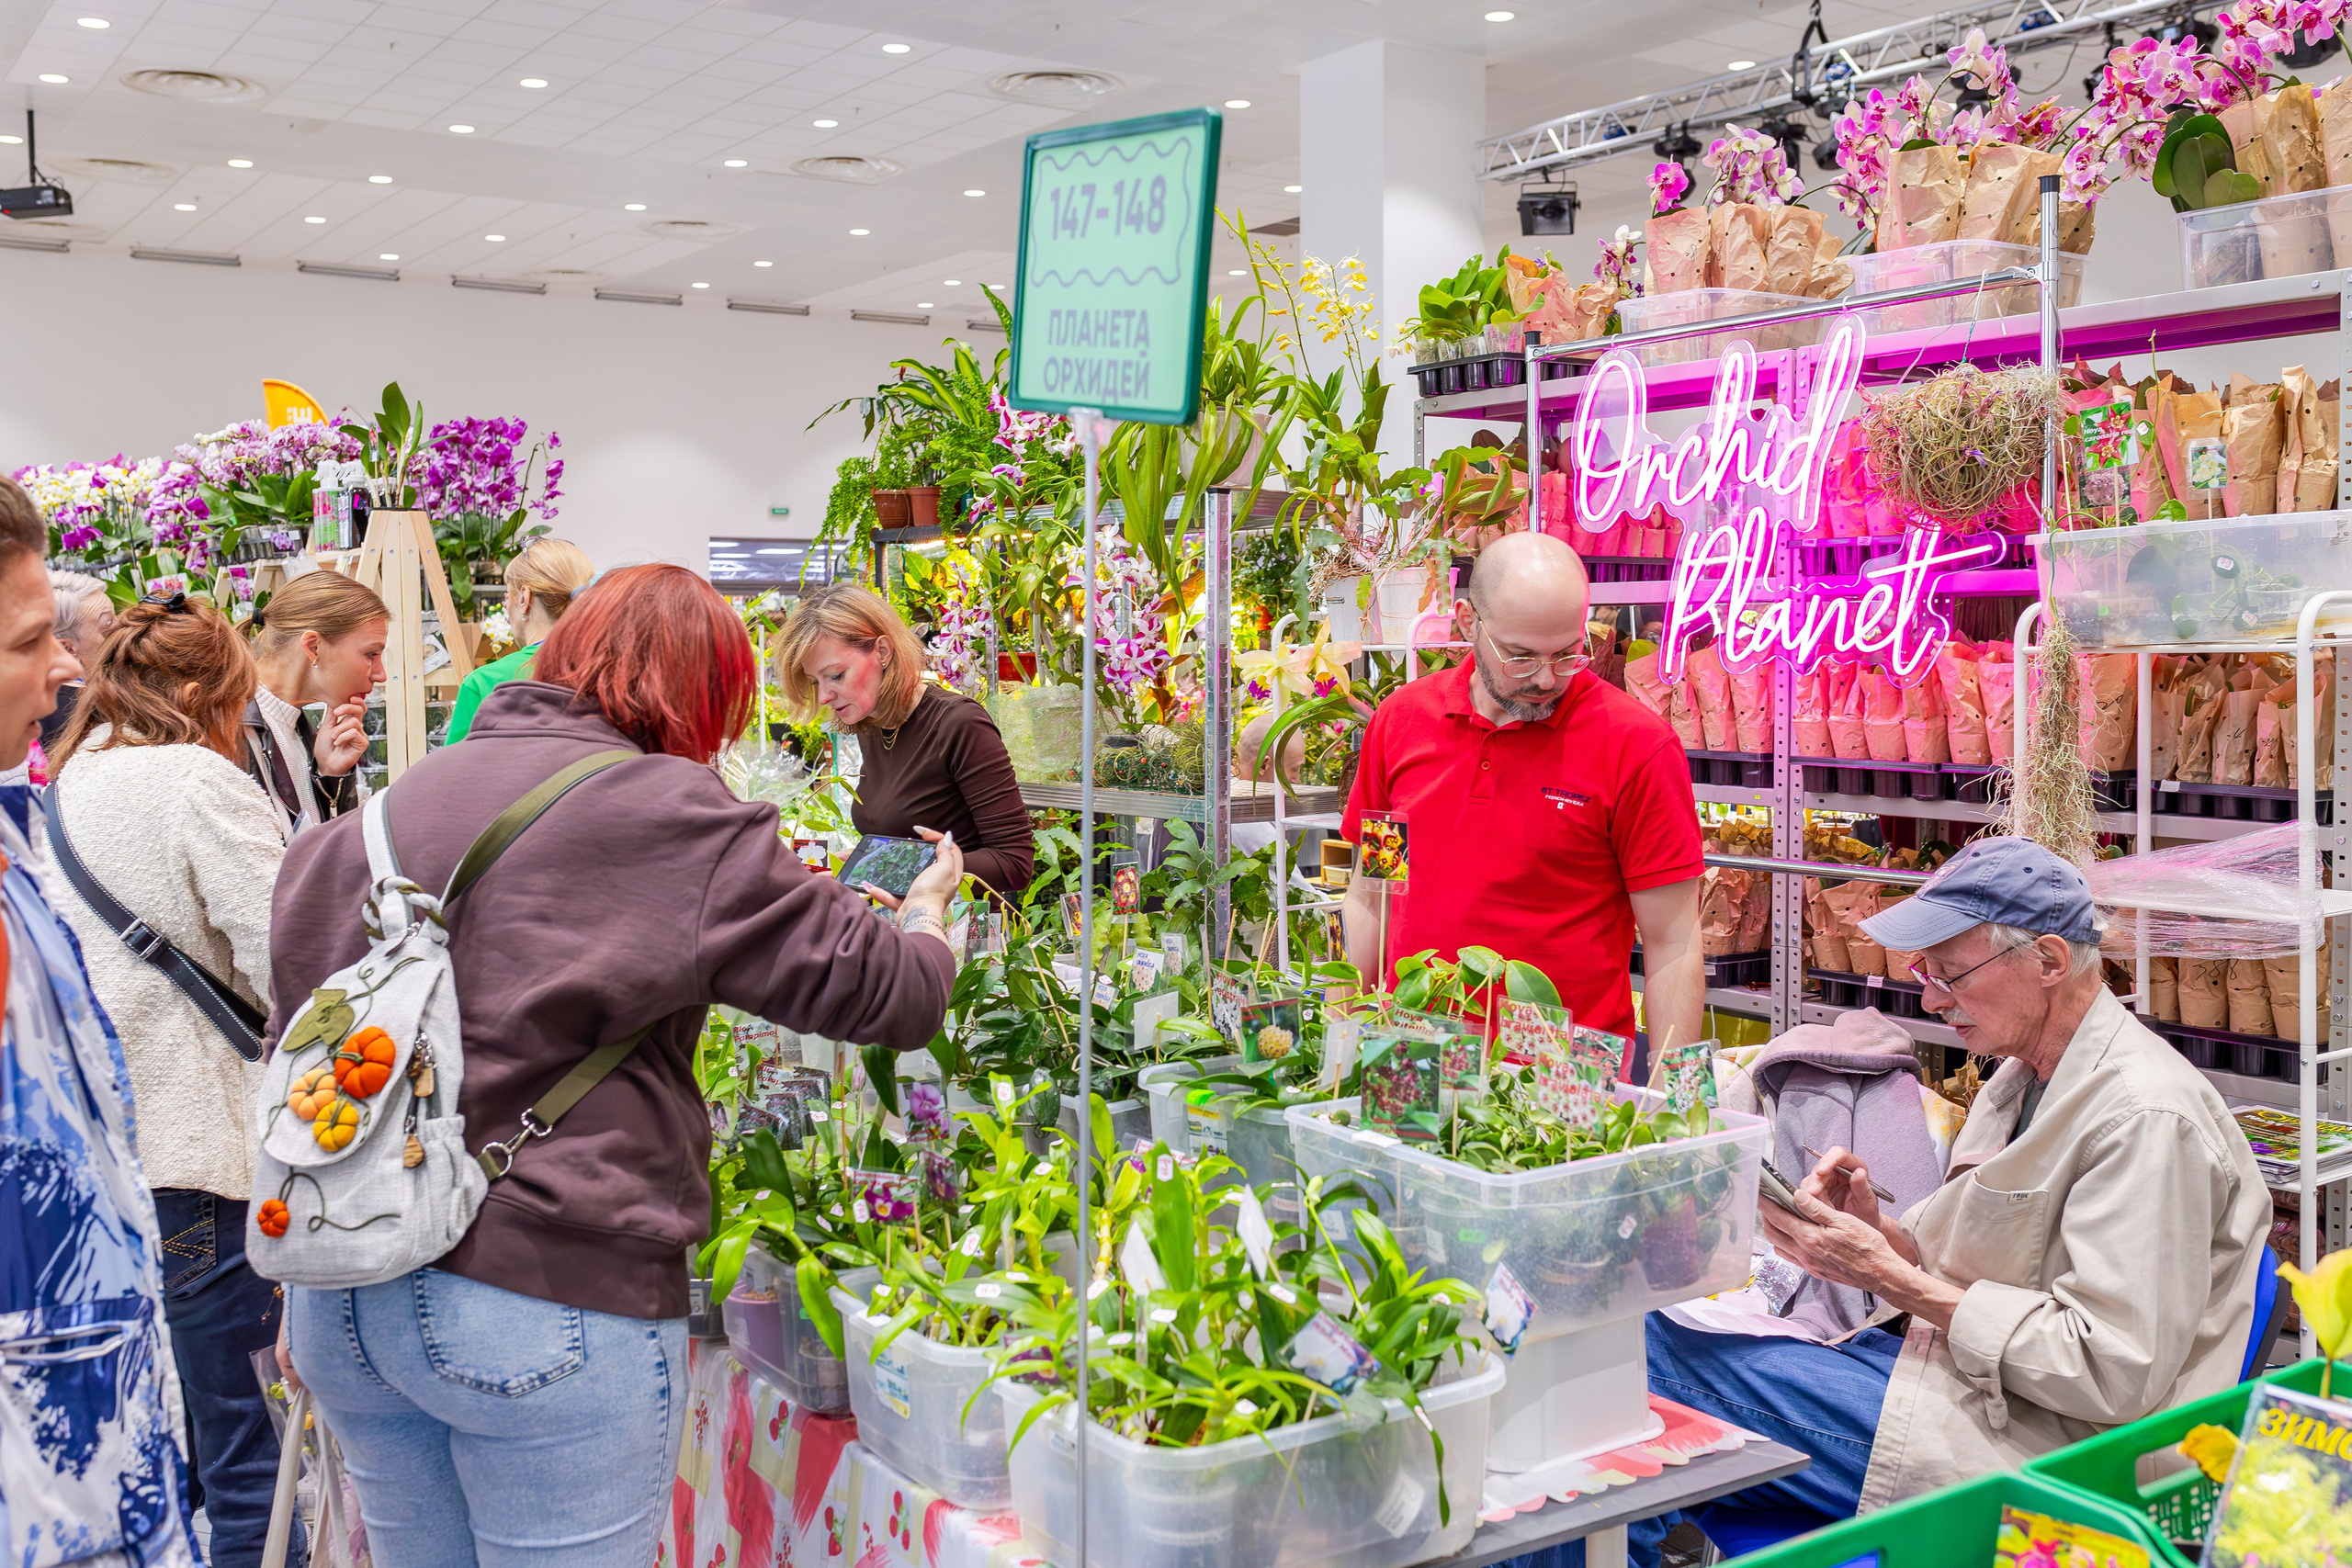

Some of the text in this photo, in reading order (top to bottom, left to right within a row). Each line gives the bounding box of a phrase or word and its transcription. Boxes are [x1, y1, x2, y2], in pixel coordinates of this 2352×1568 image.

[1050, 175, 1167, 241] 147-148
[1047, 309, 1149, 348] ПЛАНЕТА
[1043, 350, 1148, 405] ОРХИДЕЙ
[1576, 325, 1854, 524] Orchid
[2084, 427, 2101, 435] Hoya
[1665, 505, 1995, 675] Planet
[1555, 788, 1591, 804] TROPEZ
[1216, 972, 1236, 987] Hoya
[1395, 1009, 1424, 1022] Hoya
[1500, 998, 1532, 1020] Hoya
[1539, 1052, 1568, 1072] Hoya
